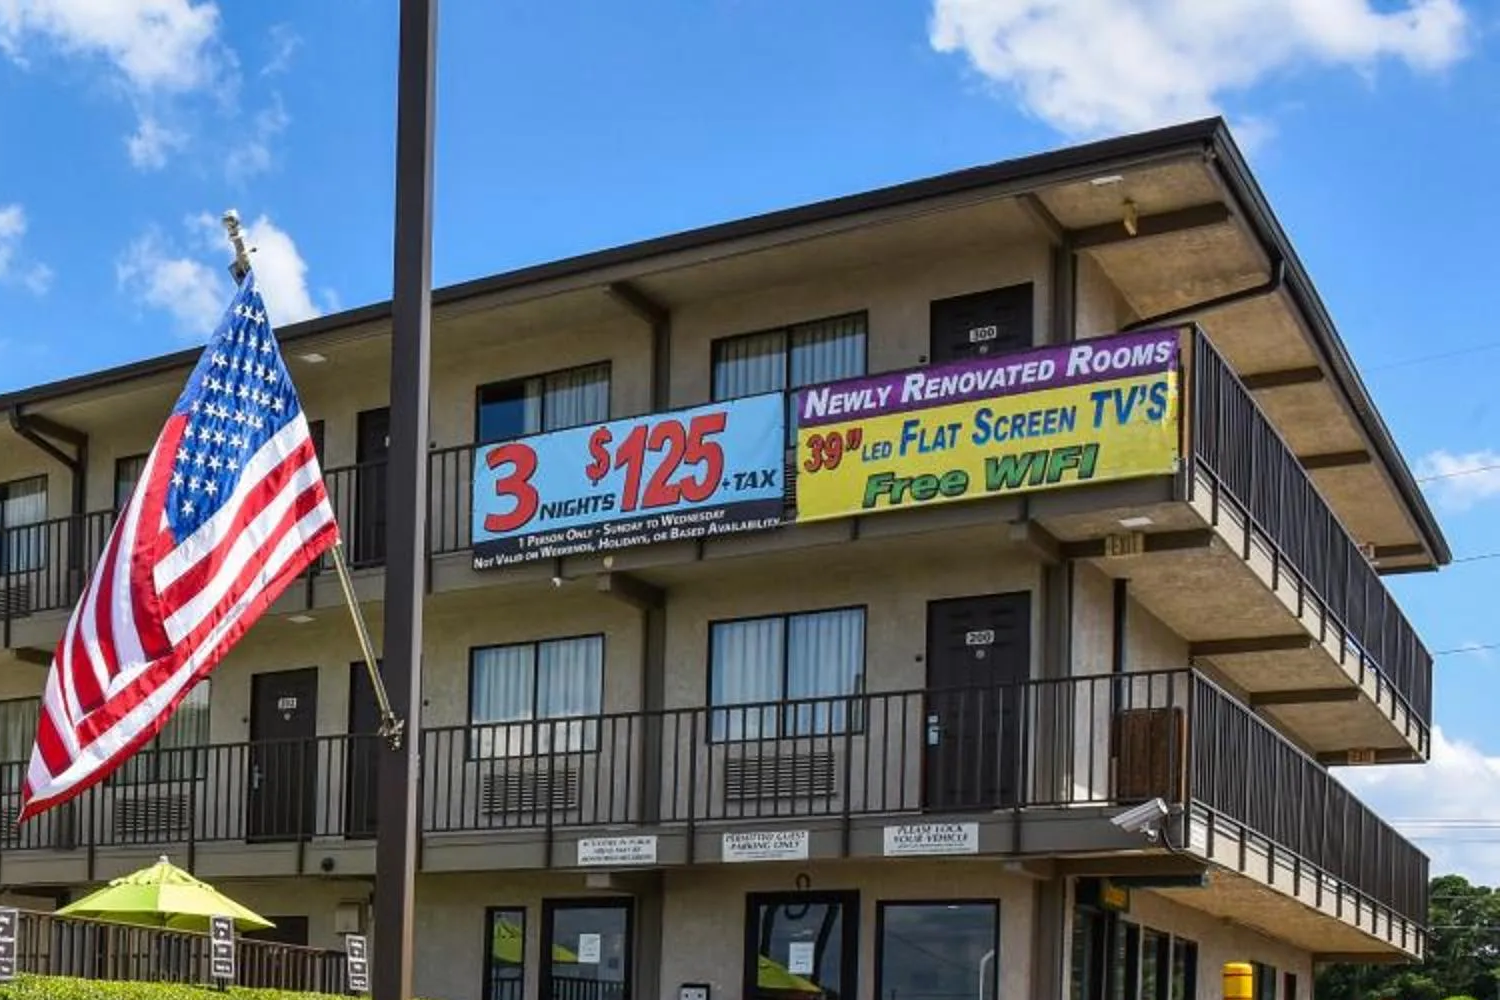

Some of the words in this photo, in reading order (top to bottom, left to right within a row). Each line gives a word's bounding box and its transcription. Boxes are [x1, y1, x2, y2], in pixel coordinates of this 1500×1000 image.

[804, 385, 892, 419] NEWLY
[901, 359, 1055, 403] RENOVATED
[1066, 341, 1173, 377] ROOMS
[862, 441, 892, 462] LED
[900, 419, 962, 456] FLAT
[972, 405, 1076, 446] SCREEN
[1090, 381, 1168, 429] TV'S
[484, 443, 538, 533] 3
[540, 493, 616, 520] NIGHTS
[586, 412, 727, 514] $125
[862, 469, 969, 508] Free
[984, 443, 1100, 492] WIFI
[474, 557, 494, 569] NOT
[670, 526, 705, 539] BASED
[518, 537, 523, 548] 1
[528, 534, 564, 548] PERSON
[565, 528, 593, 541] ONLY
[603, 521, 643, 535] SUNDAY
[661, 509, 725, 527] WEDNESDAY
